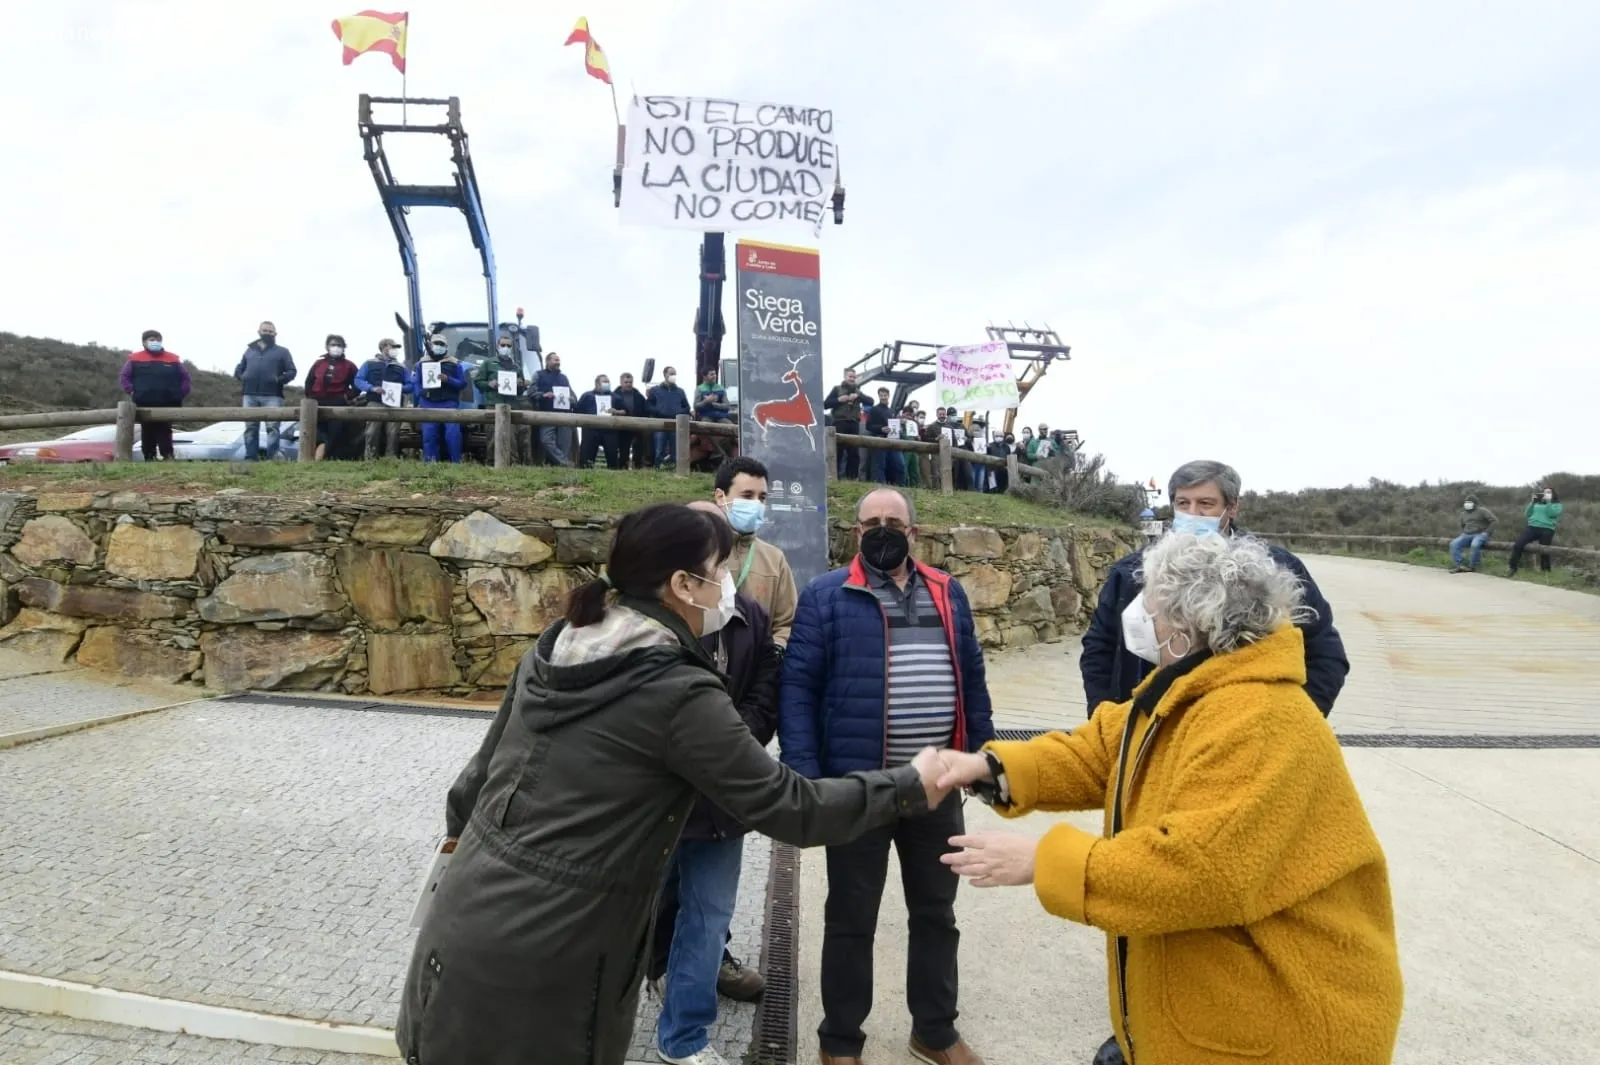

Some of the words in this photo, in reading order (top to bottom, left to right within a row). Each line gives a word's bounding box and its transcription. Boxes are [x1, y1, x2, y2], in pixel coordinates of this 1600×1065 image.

[703, 99, 755, 125] EL
[756, 103, 833, 135] CAMPO
[643, 126, 696, 156] NO
[707, 127, 834, 169] PRODUCE
[641, 161, 691, 188] LA
[674, 194, 721, 220] NO
[731, 200, 824, 223] COME
[745, 288, 804, 318] Siega
[754, 310, 818, 337] Verde
